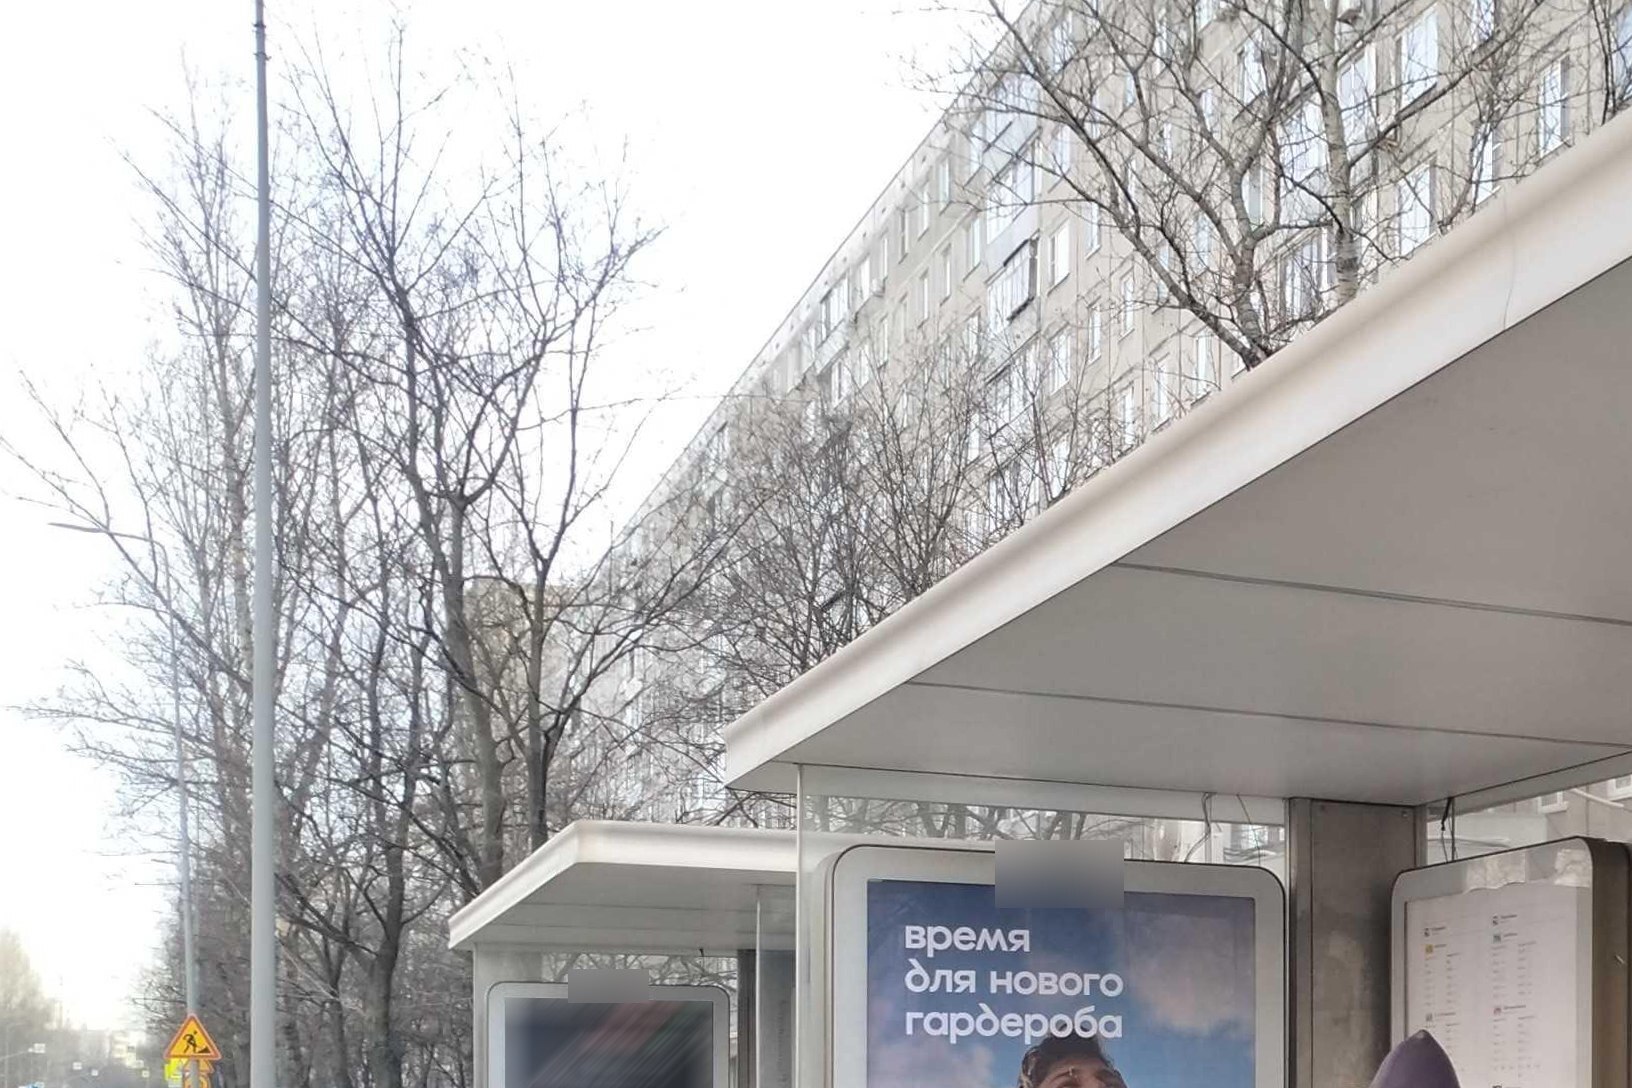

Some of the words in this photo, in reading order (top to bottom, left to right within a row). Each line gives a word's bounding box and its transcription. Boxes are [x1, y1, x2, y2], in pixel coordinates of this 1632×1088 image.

[904, 925, 1031, 958] время
[904, 958, 977, 993] для
[989, 970, 1125, 997] нового
[905, 1002, 1123, 1045] гардероба
